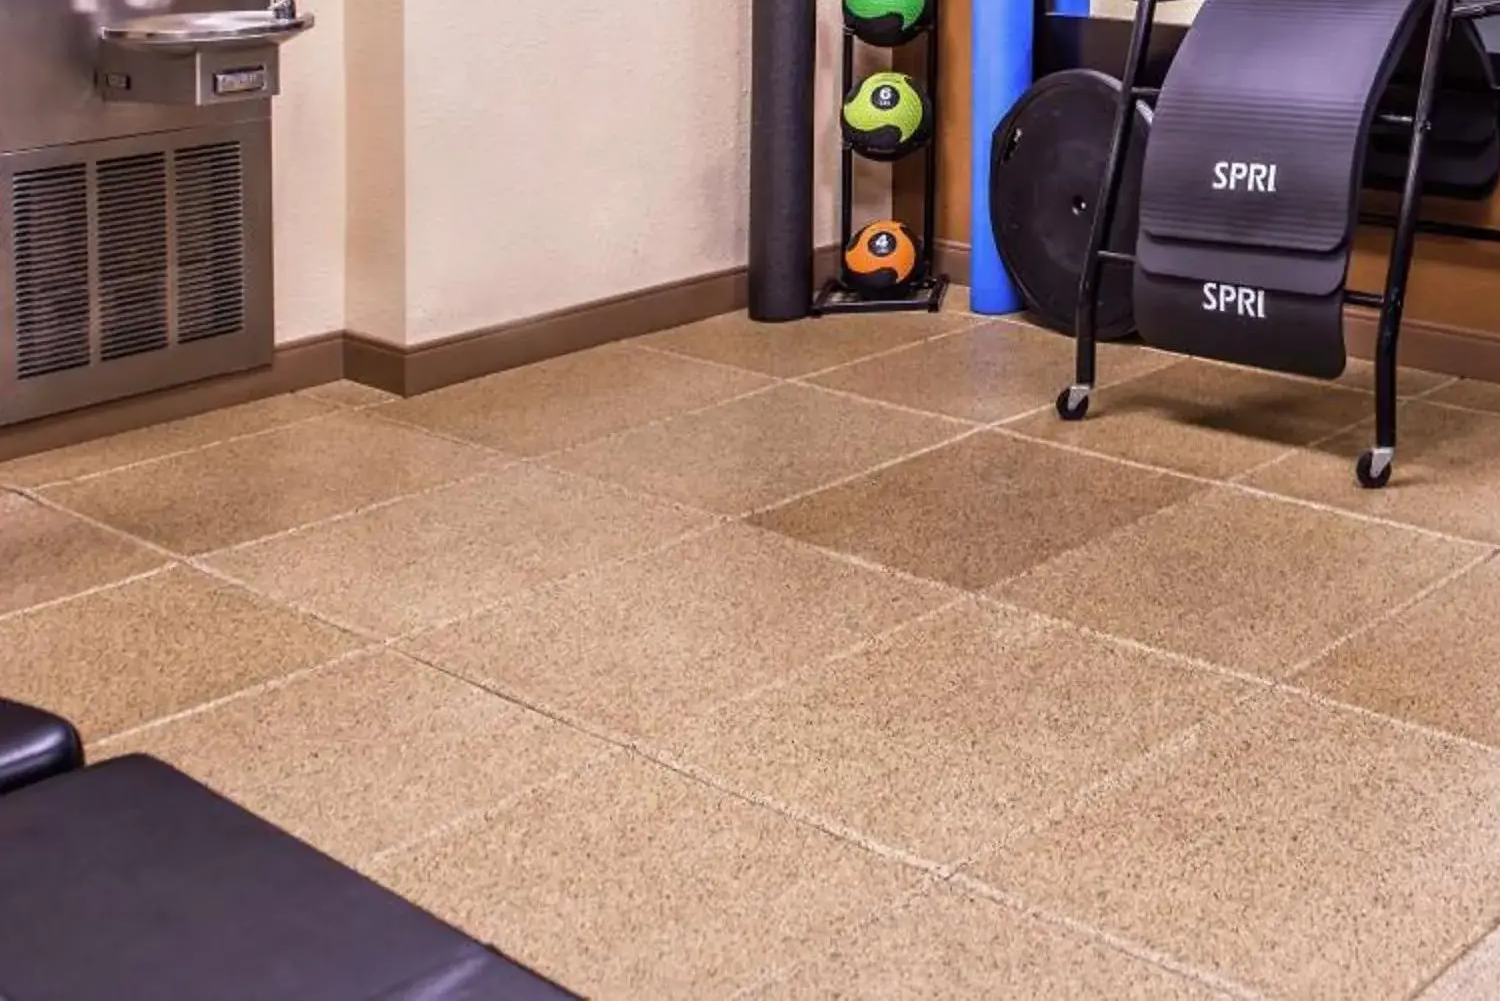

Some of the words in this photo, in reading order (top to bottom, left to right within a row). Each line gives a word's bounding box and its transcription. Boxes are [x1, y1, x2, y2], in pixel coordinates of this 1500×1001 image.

[879, 86, 892, 100] 6
[1212, 160, 1277, 193] SPRI
[875, 233, 888, 248] 4
[1202, 282, 1267, 318] SPRI
